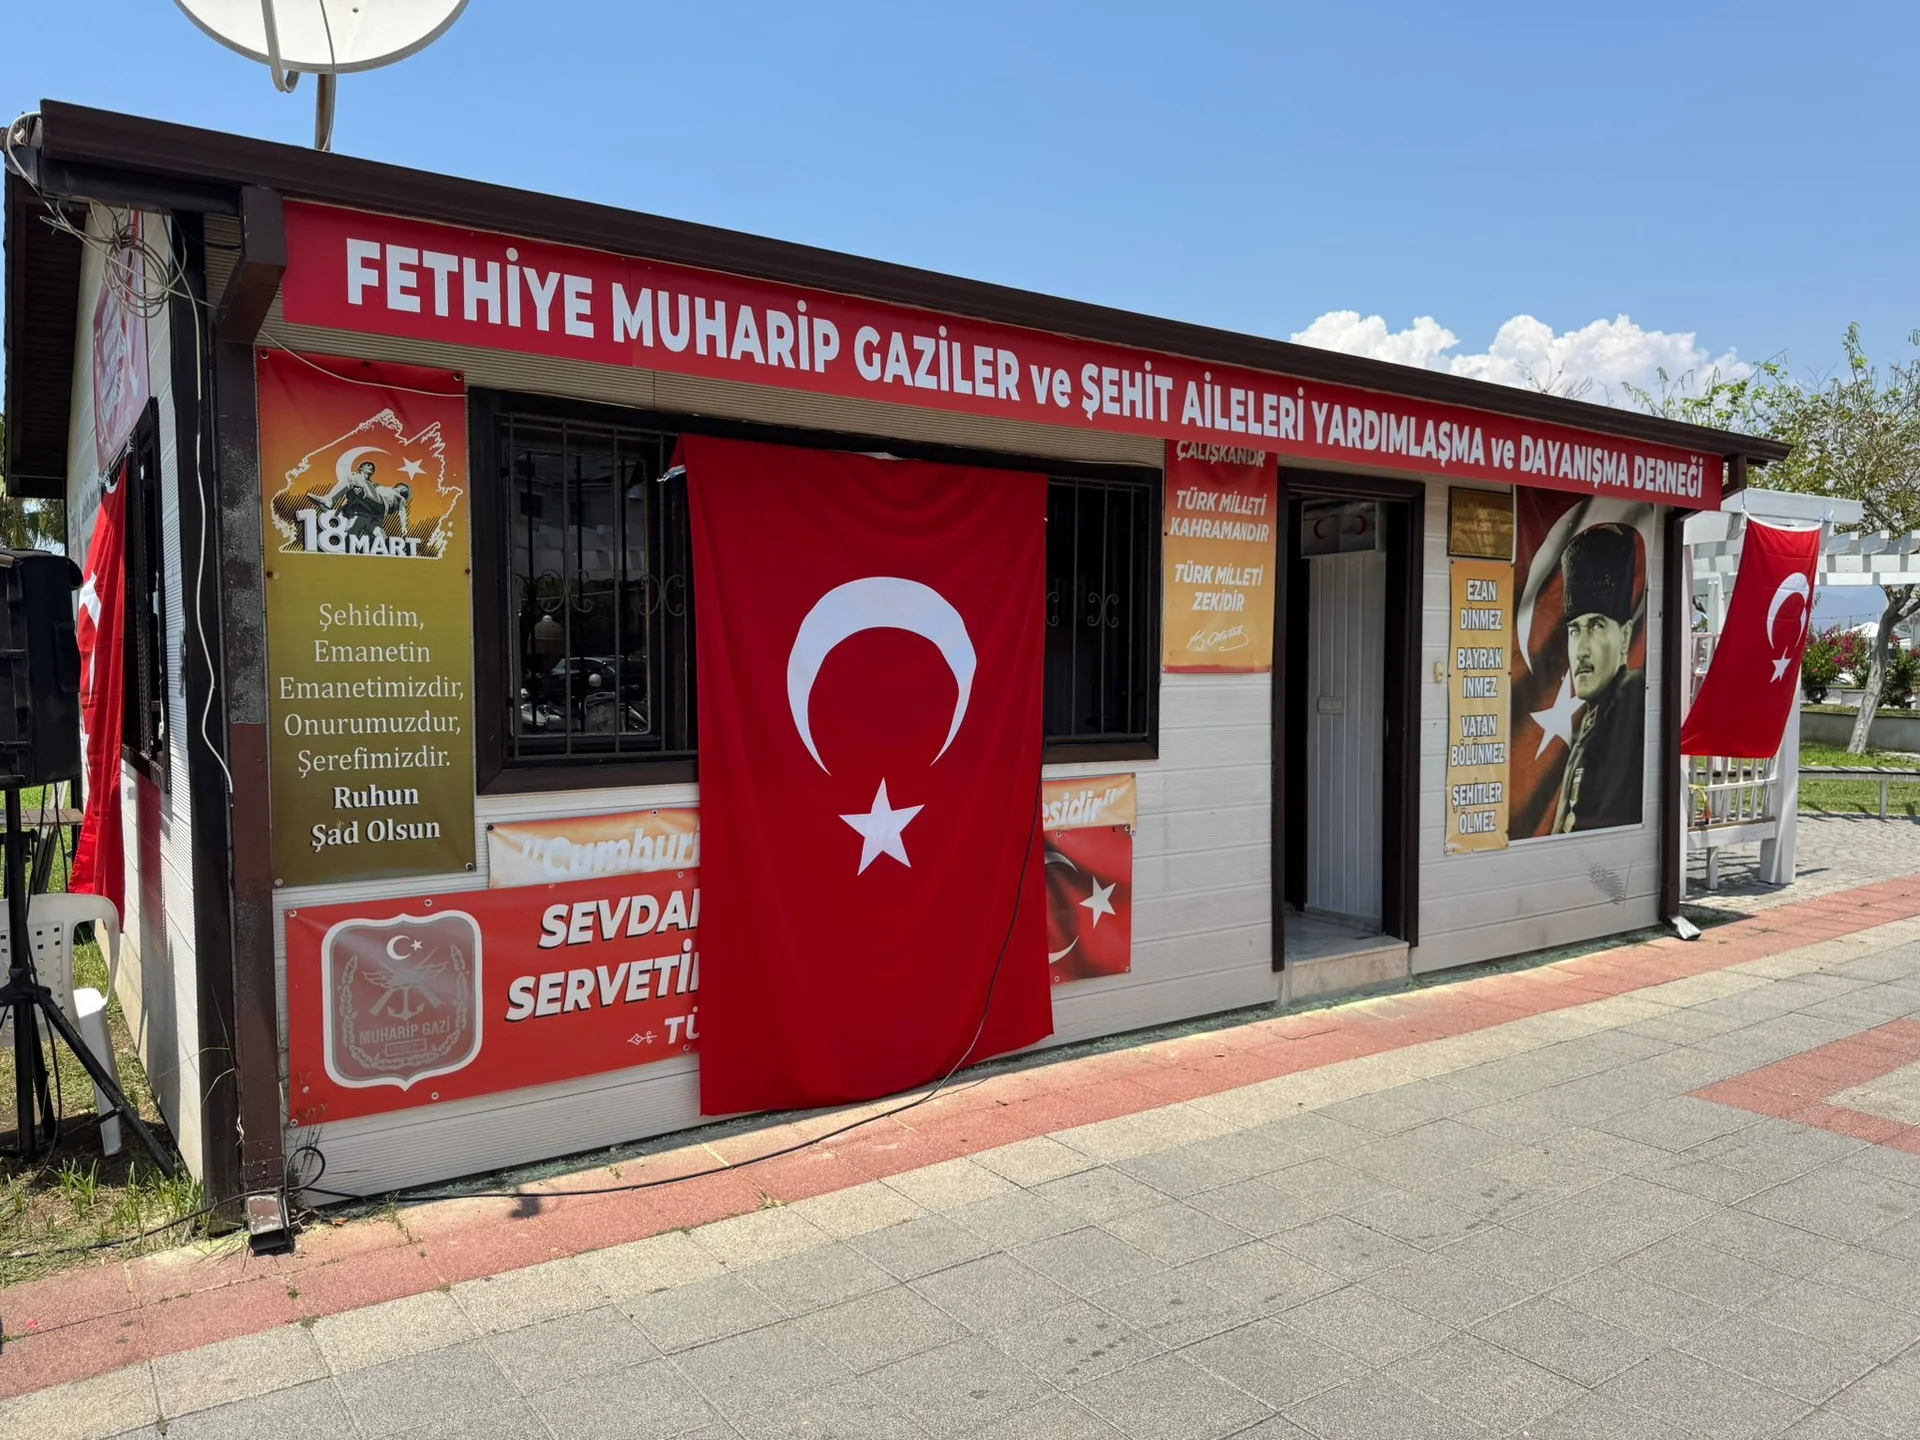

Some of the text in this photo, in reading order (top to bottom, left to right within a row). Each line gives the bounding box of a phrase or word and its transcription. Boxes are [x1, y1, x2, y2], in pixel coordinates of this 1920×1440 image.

[345, 237, 1705, 499] FETHİYE MUHARİP GAZİLER ve ŞEHİT AİLELERİ YARDIMLAŞMA ve DAYANIŞMA DERNEĞİ
[1176, 486, 1268, 517] TÜRK MİLLETİ
[296, 508, 422, 558] 18 MART
[1174, 560, 1264, 587] TÜRK MİLLETİ
[1192, 590, 1245, 612] ZEKİDİR
[1467, 579, 1497, 602] EZAN
[319, 603, 425, 633] Şehidim,
[1460, 603, 1502, 631] DİNMEZ
[314, 639, 431, 663] Emanetin
[1457, 647, 1503, 670] BAYRAK
[279, 675, 464, 701] Emanetimizdir,
[1463, 671, 1498, 698] İNMEZ
[284, 710, 461, 737] Onurumuzdur,
[1461, 714, 1497, 737] VATAN
[298, 746, 450, 778] Şerefimizdir.
[1450, 738, 1505, 767] BÖLÜNMEZ
[332, 785, 419, 810] Ruhun
[1451, 777, 1503, 813] ŞEHİTLER
[1459, 808, 1496, 834] ÖLMEZ
[311, 818, 441, 853] Şad Olsun
[360, 1016, 450, 1045] MUHARİP GAZİ
